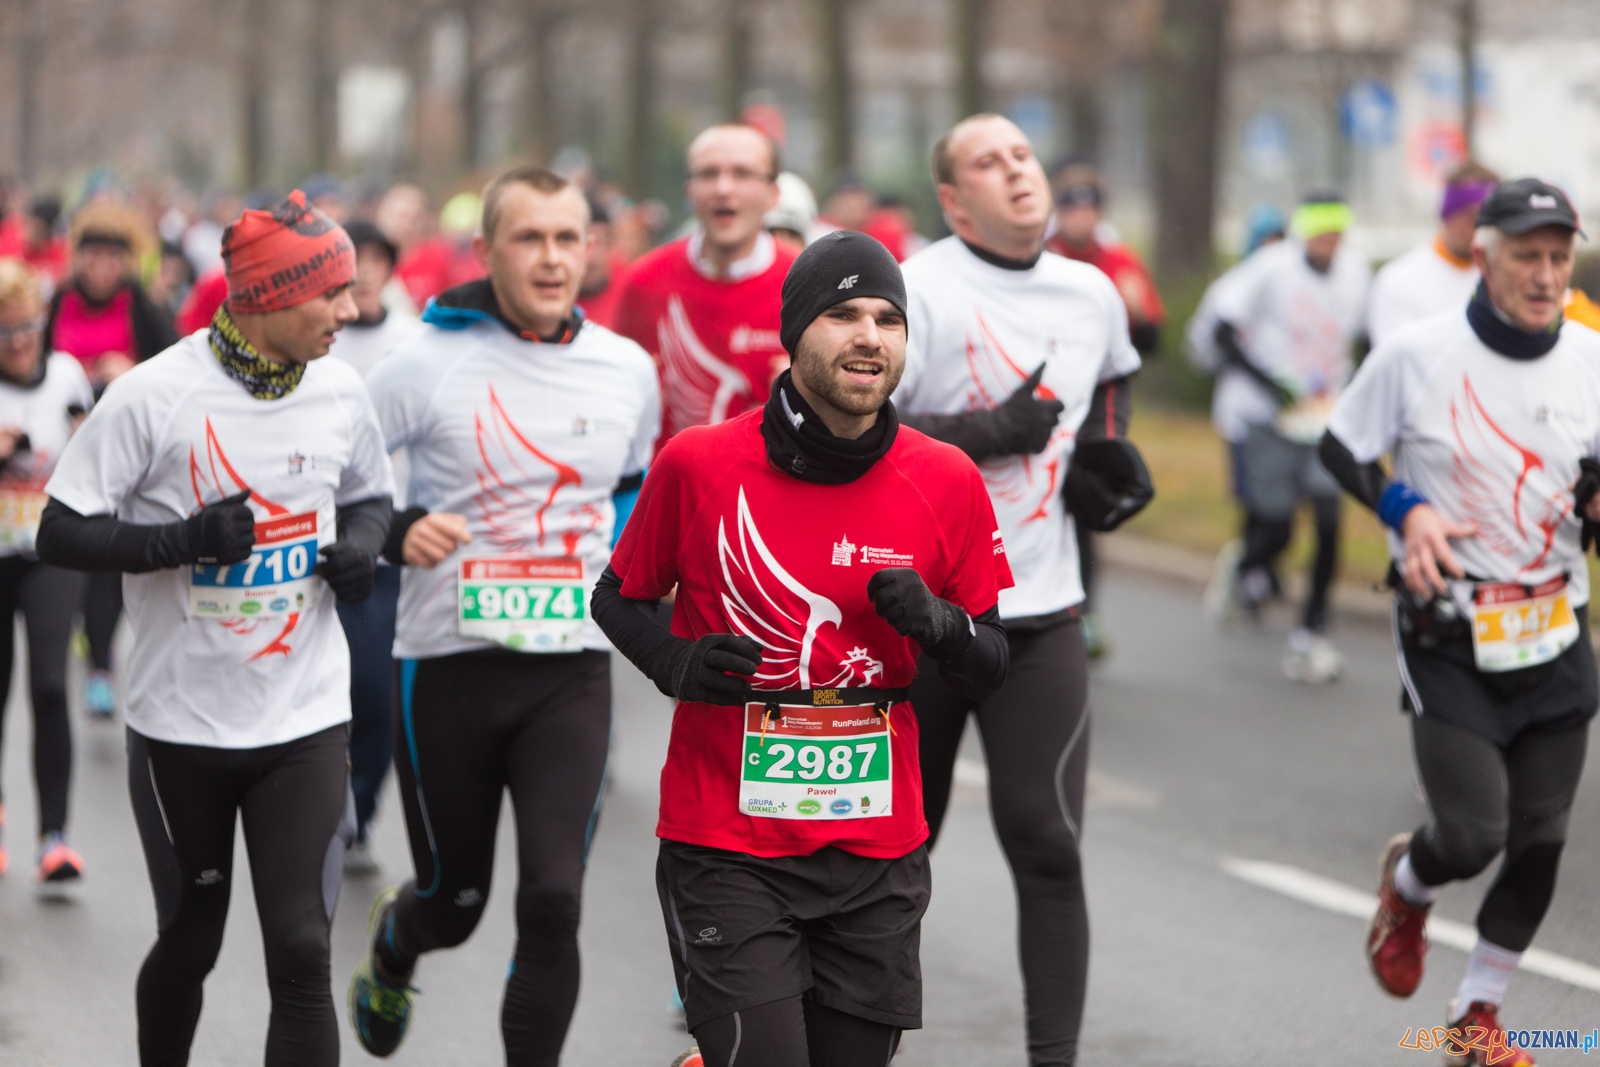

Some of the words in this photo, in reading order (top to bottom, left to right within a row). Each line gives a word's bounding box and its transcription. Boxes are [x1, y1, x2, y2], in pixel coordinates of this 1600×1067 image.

[477, 586, 578, 618] 9074
[832, 717, 880, 728] RunPoland.org
[748, 752, 760, 765] C
[764, 742, 878, 780] 2987
[748, 806, 778, 814] LUXMED
